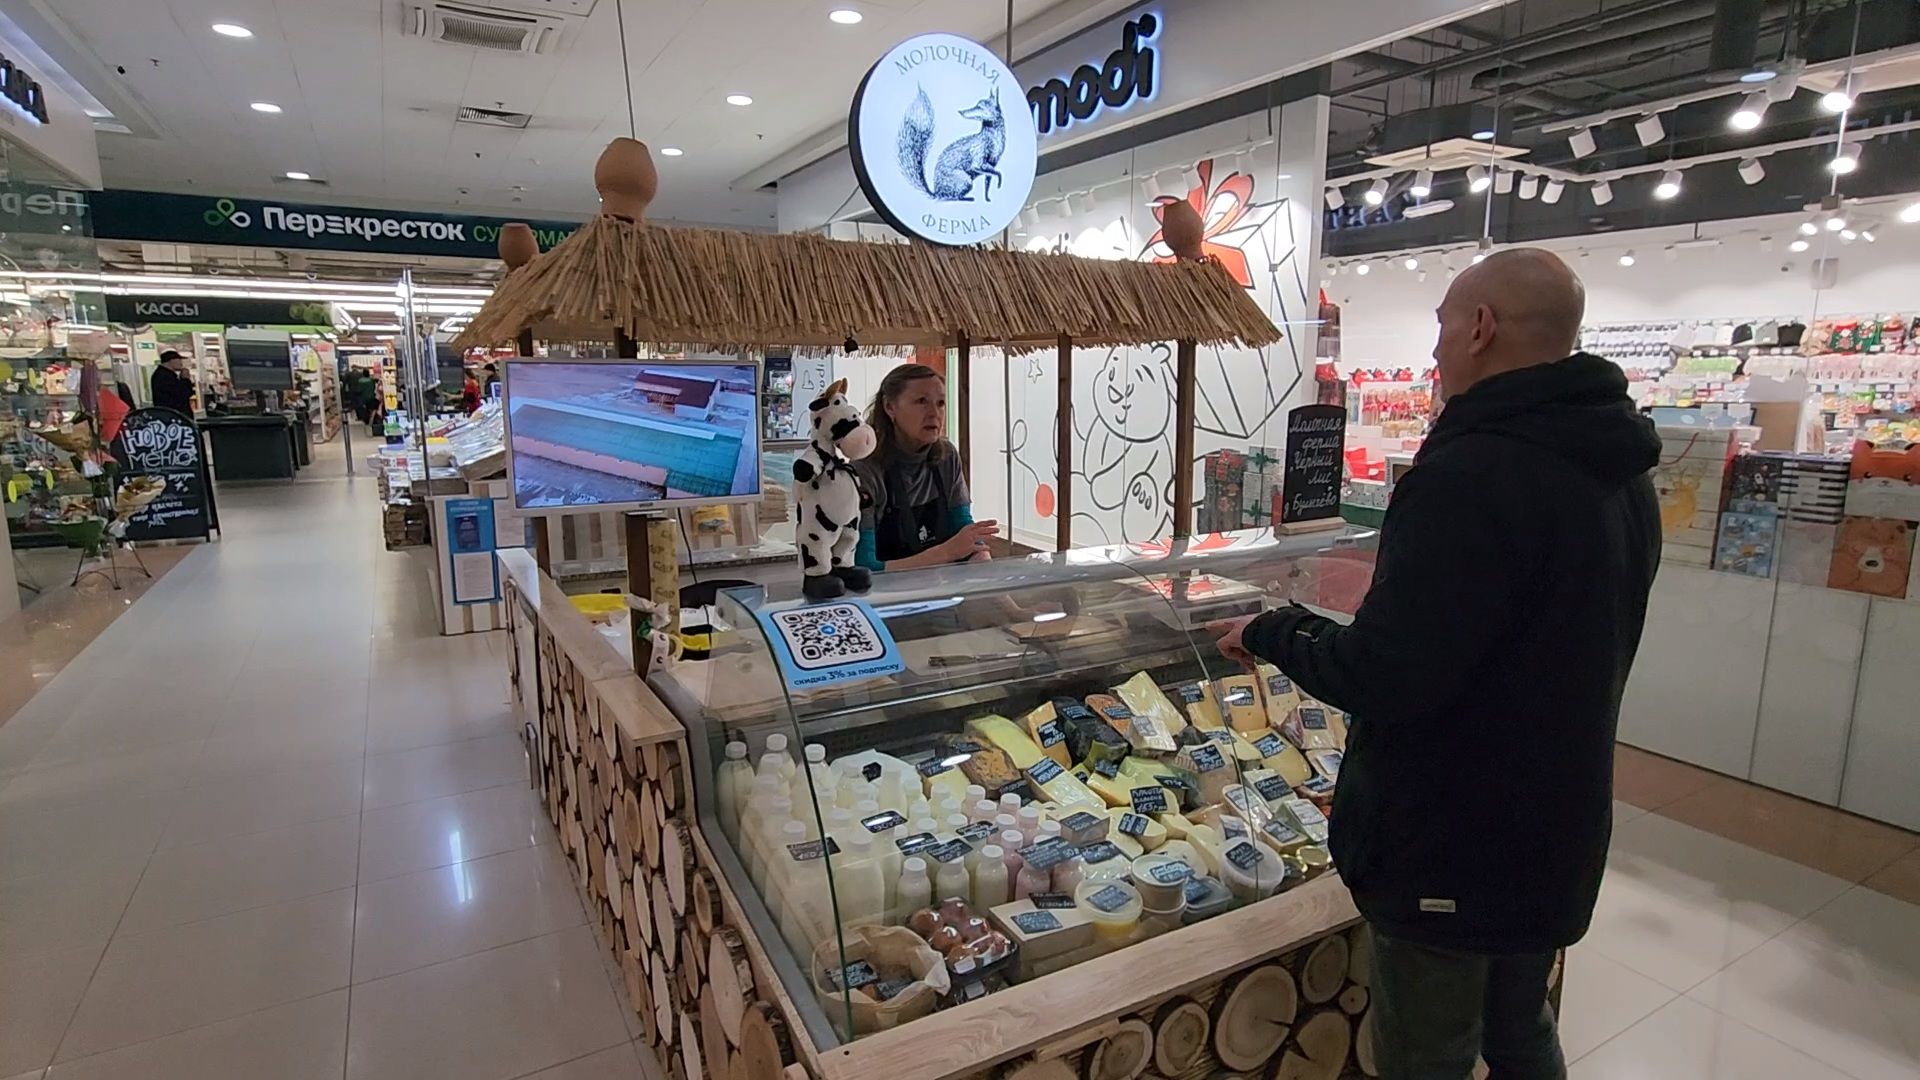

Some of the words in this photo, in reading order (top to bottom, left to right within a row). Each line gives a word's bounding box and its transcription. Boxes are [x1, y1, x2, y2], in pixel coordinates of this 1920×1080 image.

[894, 44, 1000, 85] МОЛОЧНАЯ
[1026, 13, 1156, 134] modi
[262, 206, 467, 242] Перекресток
[920, 213, 991, 235] ФЕРМА
[135, 302, 199, 316] КАССЫ
[1302, 435, 1340, 456] ферма
[793, 676, 827, 686] скидка
[827, 670, 845, 681] 3%
[846, 670, 857, 678] за
[858, 664, 900, 675] подписку
